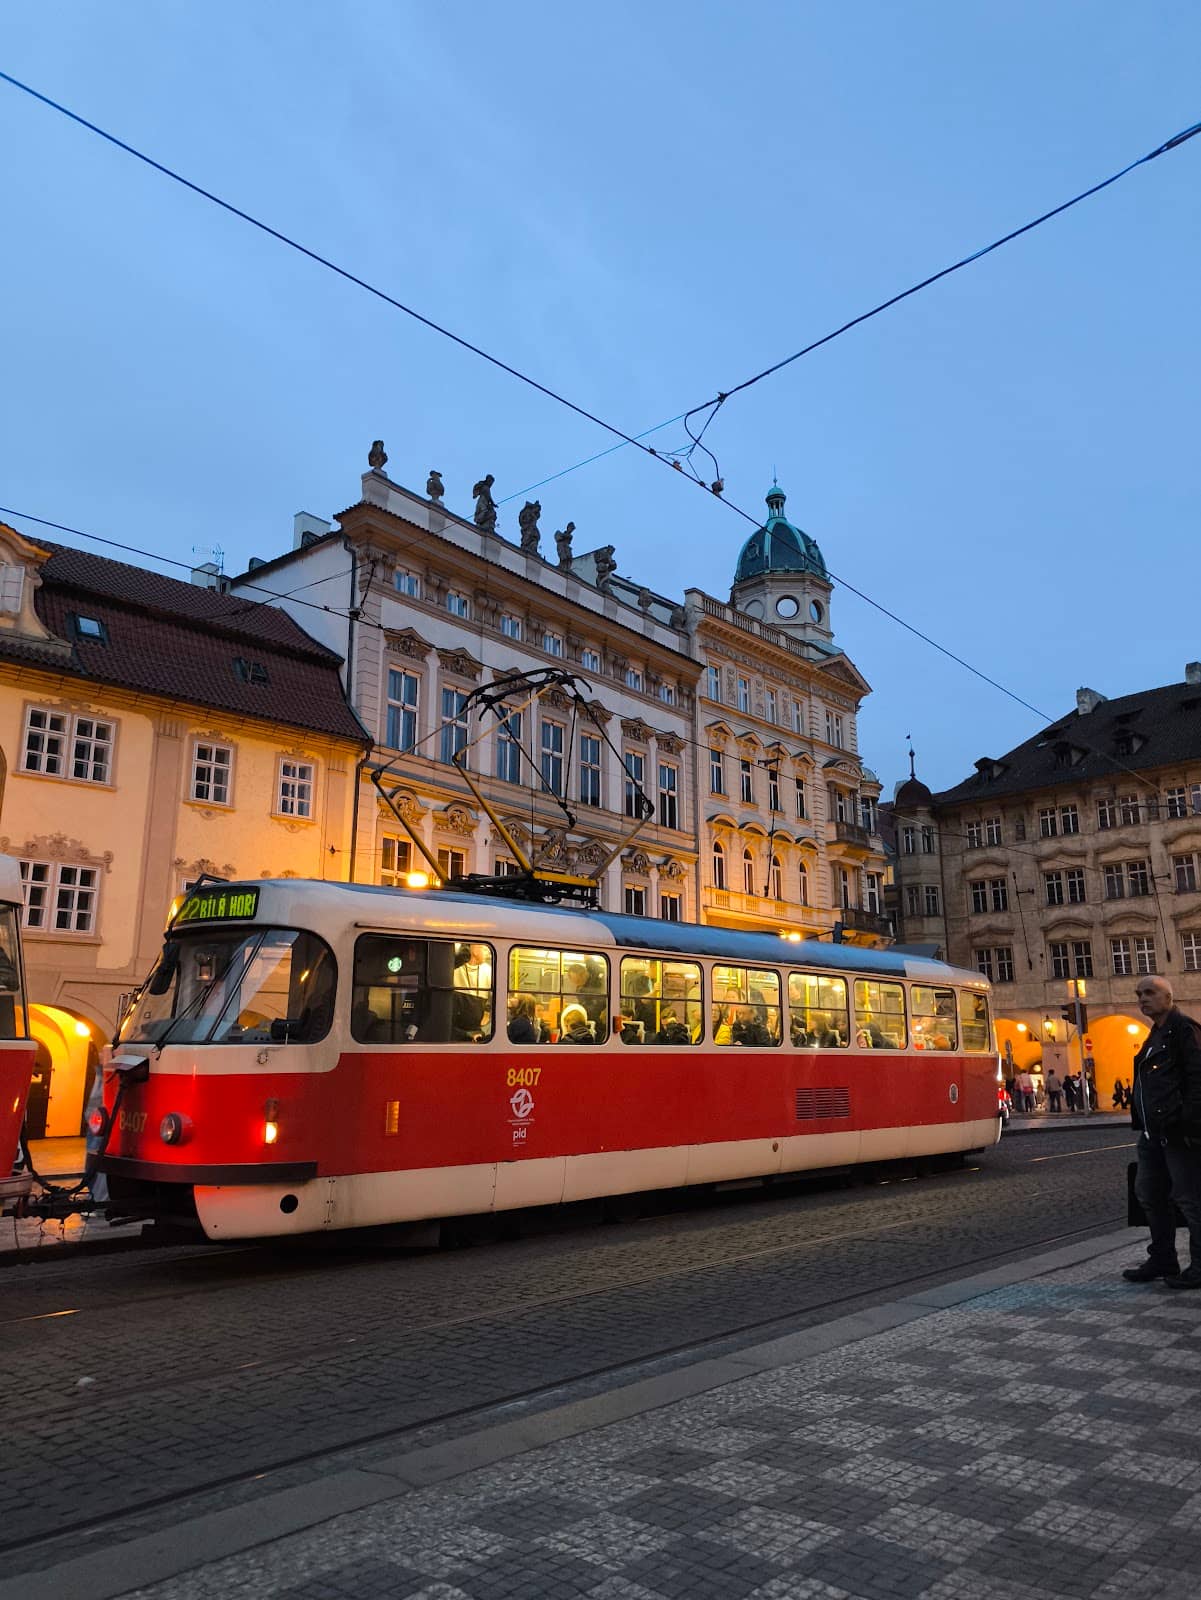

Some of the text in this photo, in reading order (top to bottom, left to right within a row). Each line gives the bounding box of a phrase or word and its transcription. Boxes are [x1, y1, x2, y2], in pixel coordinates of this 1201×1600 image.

[200, 893, 226, 919] BÍLÁ
[507, 1068, 541, 1086] 8407
[120, 1110, 147, 1132] 8407
[513, 1128, 526, 1141] pid
